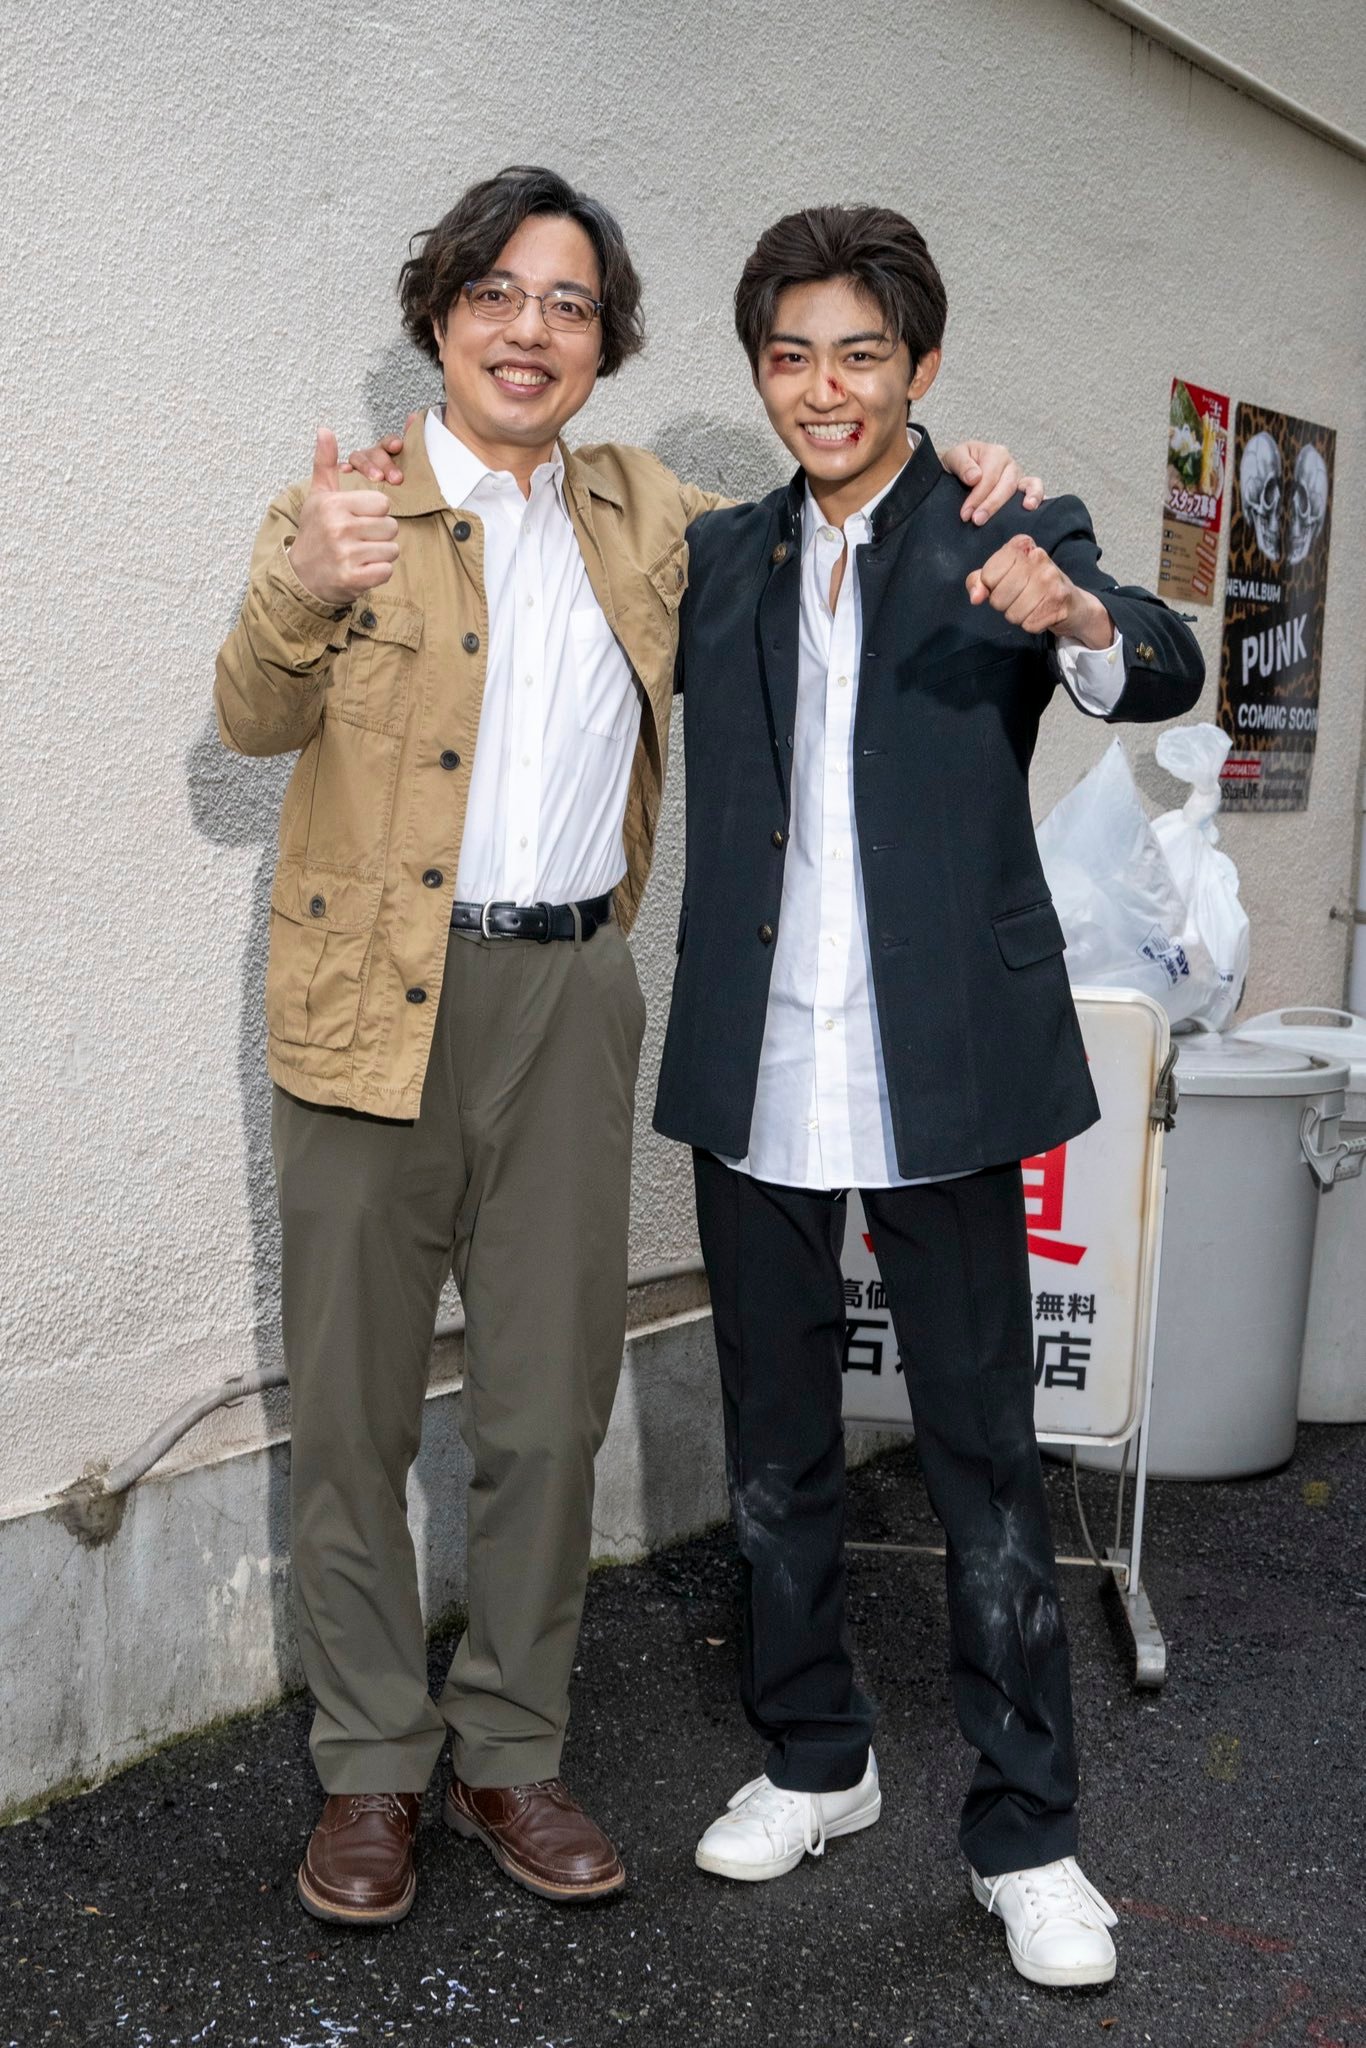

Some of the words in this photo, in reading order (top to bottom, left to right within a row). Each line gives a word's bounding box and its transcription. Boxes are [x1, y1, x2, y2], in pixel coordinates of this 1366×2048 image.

[1248, 580, 1281, 603] ALBUM
[1242, 613, 1308, 687] PUNK
[1238, 703, 1287, 731] COMING
[1288, 706, 1318, 732] SOON
[1035, 1291, 1097, 1324] 無料
[1034, 1331, 1092, 1391] 店
